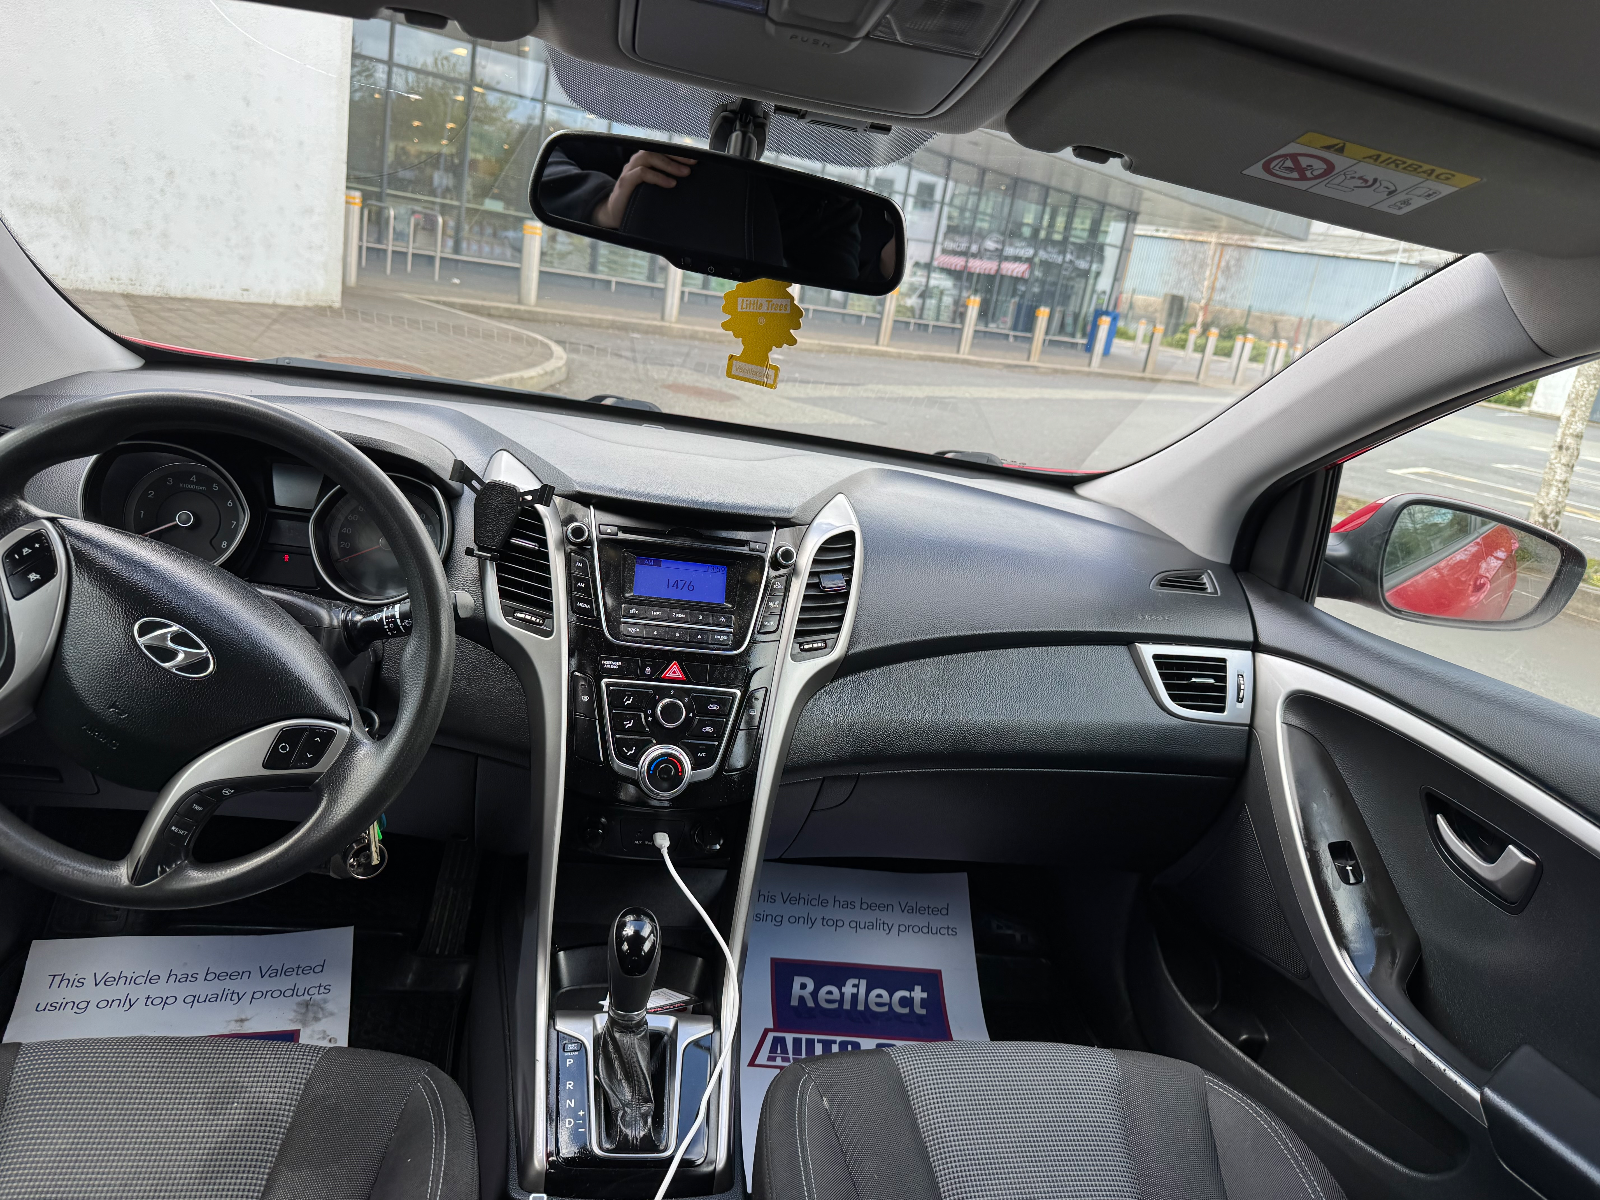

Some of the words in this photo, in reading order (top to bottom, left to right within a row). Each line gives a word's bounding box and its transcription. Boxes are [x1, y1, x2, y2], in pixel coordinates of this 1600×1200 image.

[1362, 153, 1456, 182] AIRBAG
[740, 298, 763, 311] Little
[765, 300, 788, 312] Trees
[212, 483, 219, 491] 5
[231, 521, 237, 529] 7
[667, 578, 695, 592] 1476
[171, 825, 188, 836] RESET
[757, 889, 777, 904] his
[780, 891, 829, 908] Vehicle
[833, 895, 856, 910] has
[859, 898, 895, 913] been
[899, 901, 949, 916] Valeted
[753, 910, 784, 927] sing
[787, 912, 817, 927] only
[821, 916, 845, 931] top
[849, 918, 894, 933] quality
[897, 923, 958, 936] products
[48, 972, 86, 989] This
[93, 969, 161, 987] Vehicle
[165, 968, 199, 984] has
[203, 967, 252, 982] been
[259, 959, 326, 979] Valeted
[35, 997, 91, 1015] using
[95, 992, 140, 1012] only
[144, 994, 178, 1010] top
[182, 987, 247, 1009] quality
[249, 982, 332, 1005] products
[790, 975, 928, 1015] Reflect
[566, 1059, 574, 1068] P
[566, 1081, 574, 1090] R
[566, 1099, 574, 1108] N
[566, 1119, 574, 1128] D
